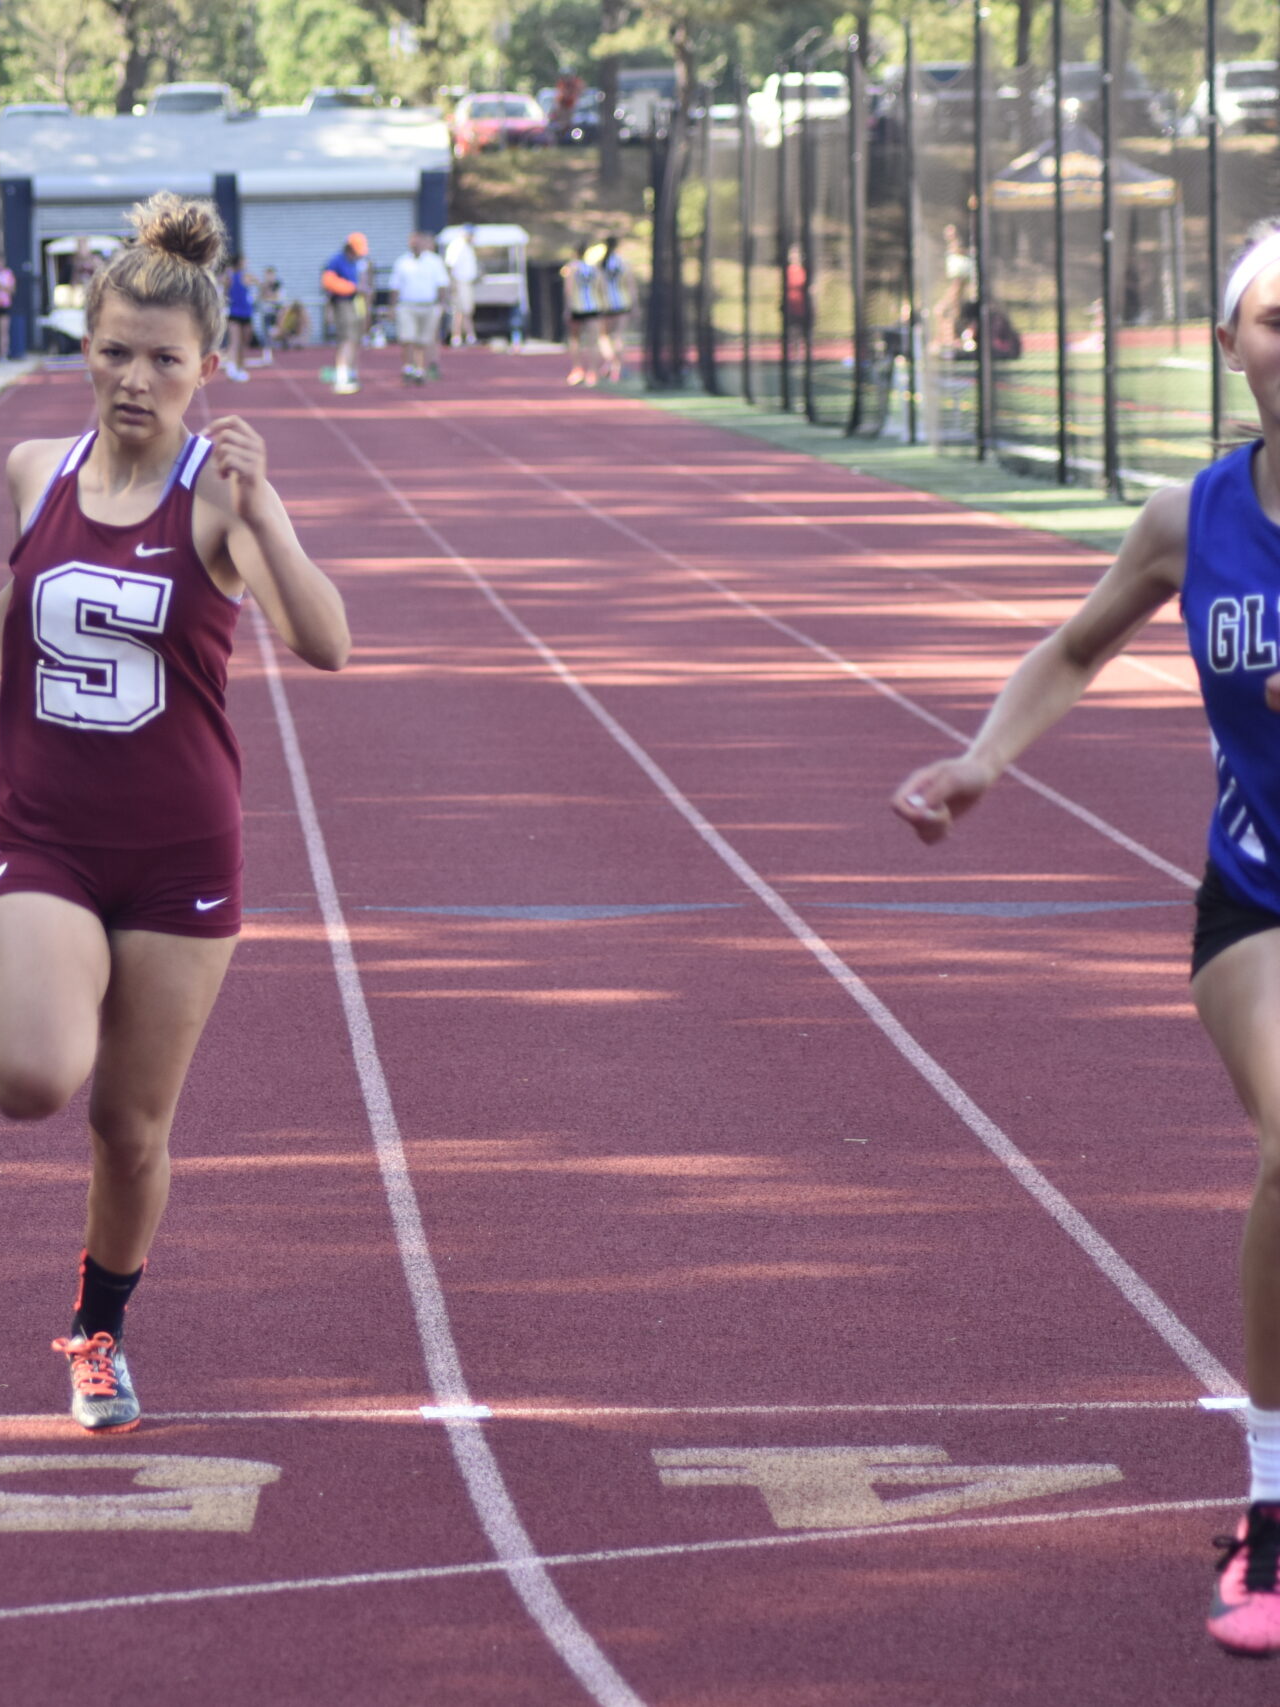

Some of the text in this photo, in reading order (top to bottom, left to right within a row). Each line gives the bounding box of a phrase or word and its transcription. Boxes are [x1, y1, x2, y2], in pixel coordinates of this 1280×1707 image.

[33, 561, 173, 733] S
[1209, 594, 1280, 673] GL
[651, 1445, 1123, 1528] 4
